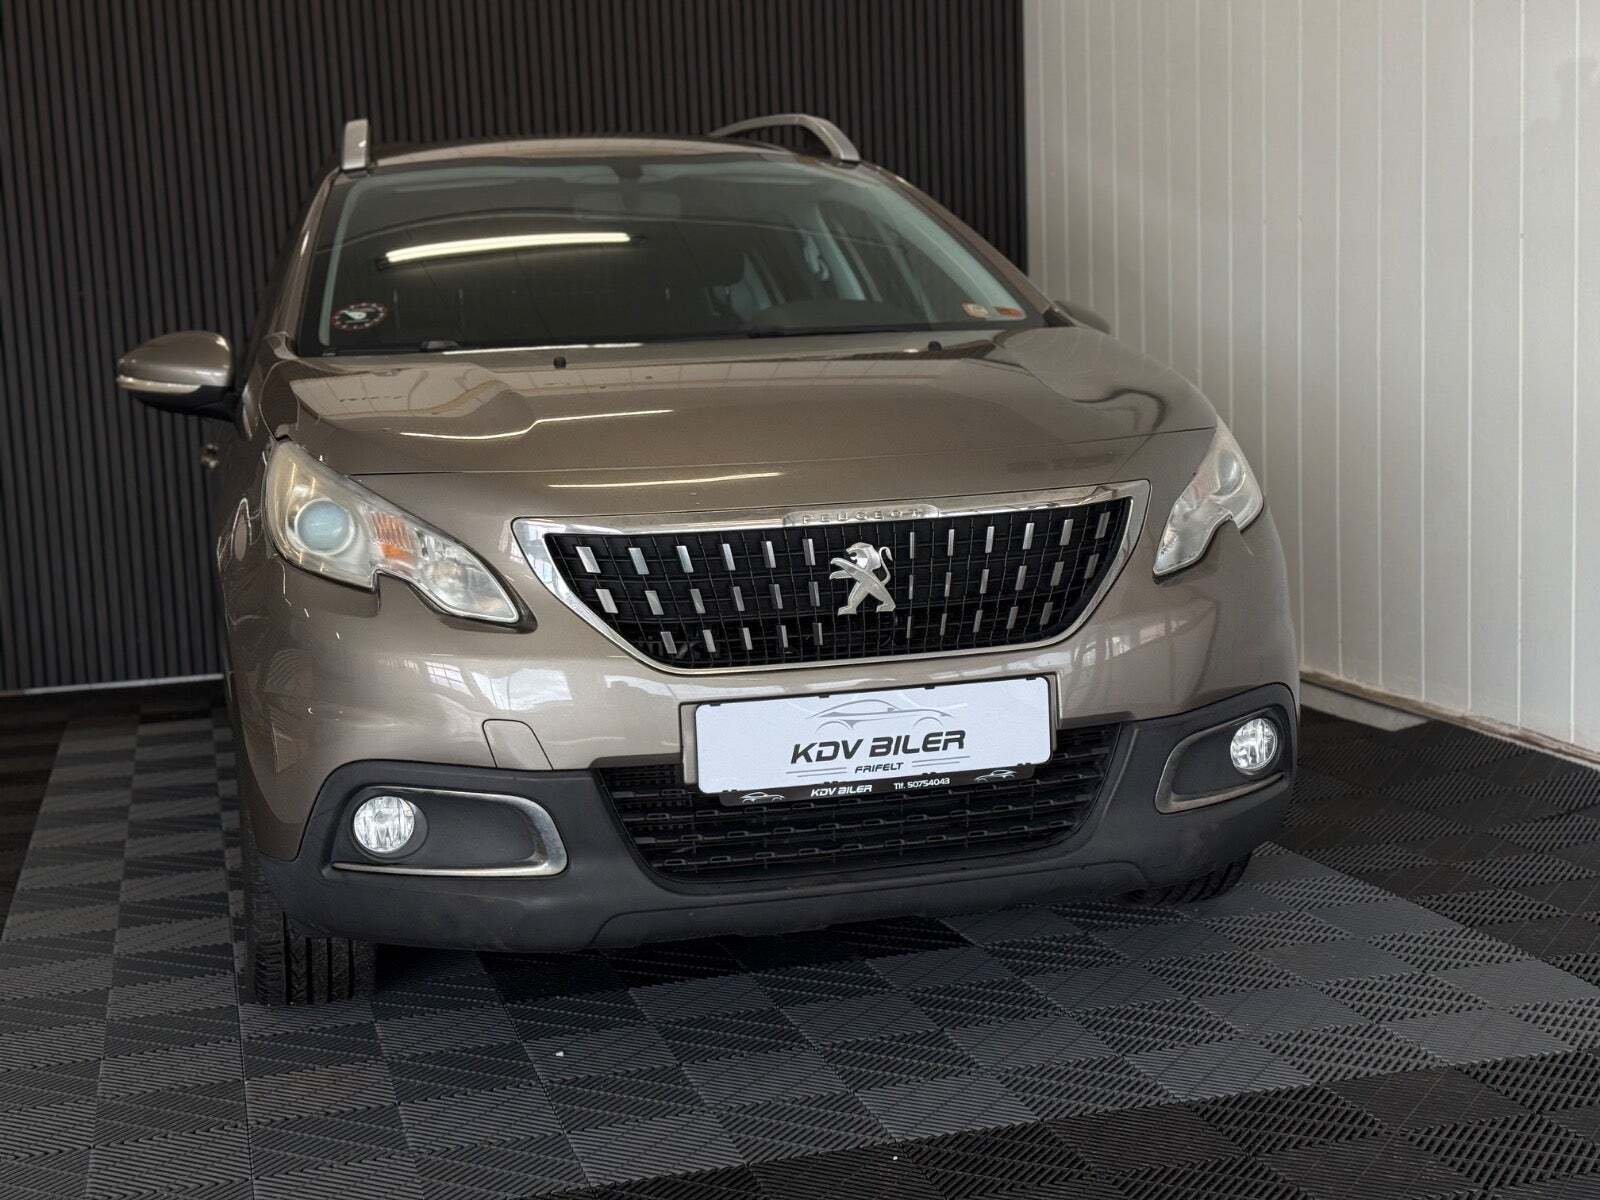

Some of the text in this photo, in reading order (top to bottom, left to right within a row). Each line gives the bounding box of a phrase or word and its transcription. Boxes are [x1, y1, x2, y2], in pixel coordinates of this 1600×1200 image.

[802, 510, 922, 525] PEUGEOT
[790, 730, 966, 764] KDV BILER
[855, 762, 904, 774] FRIFELT
[907, 777, 951, 789] 50754043
[810, 784, 873, 797] KDV BILER
